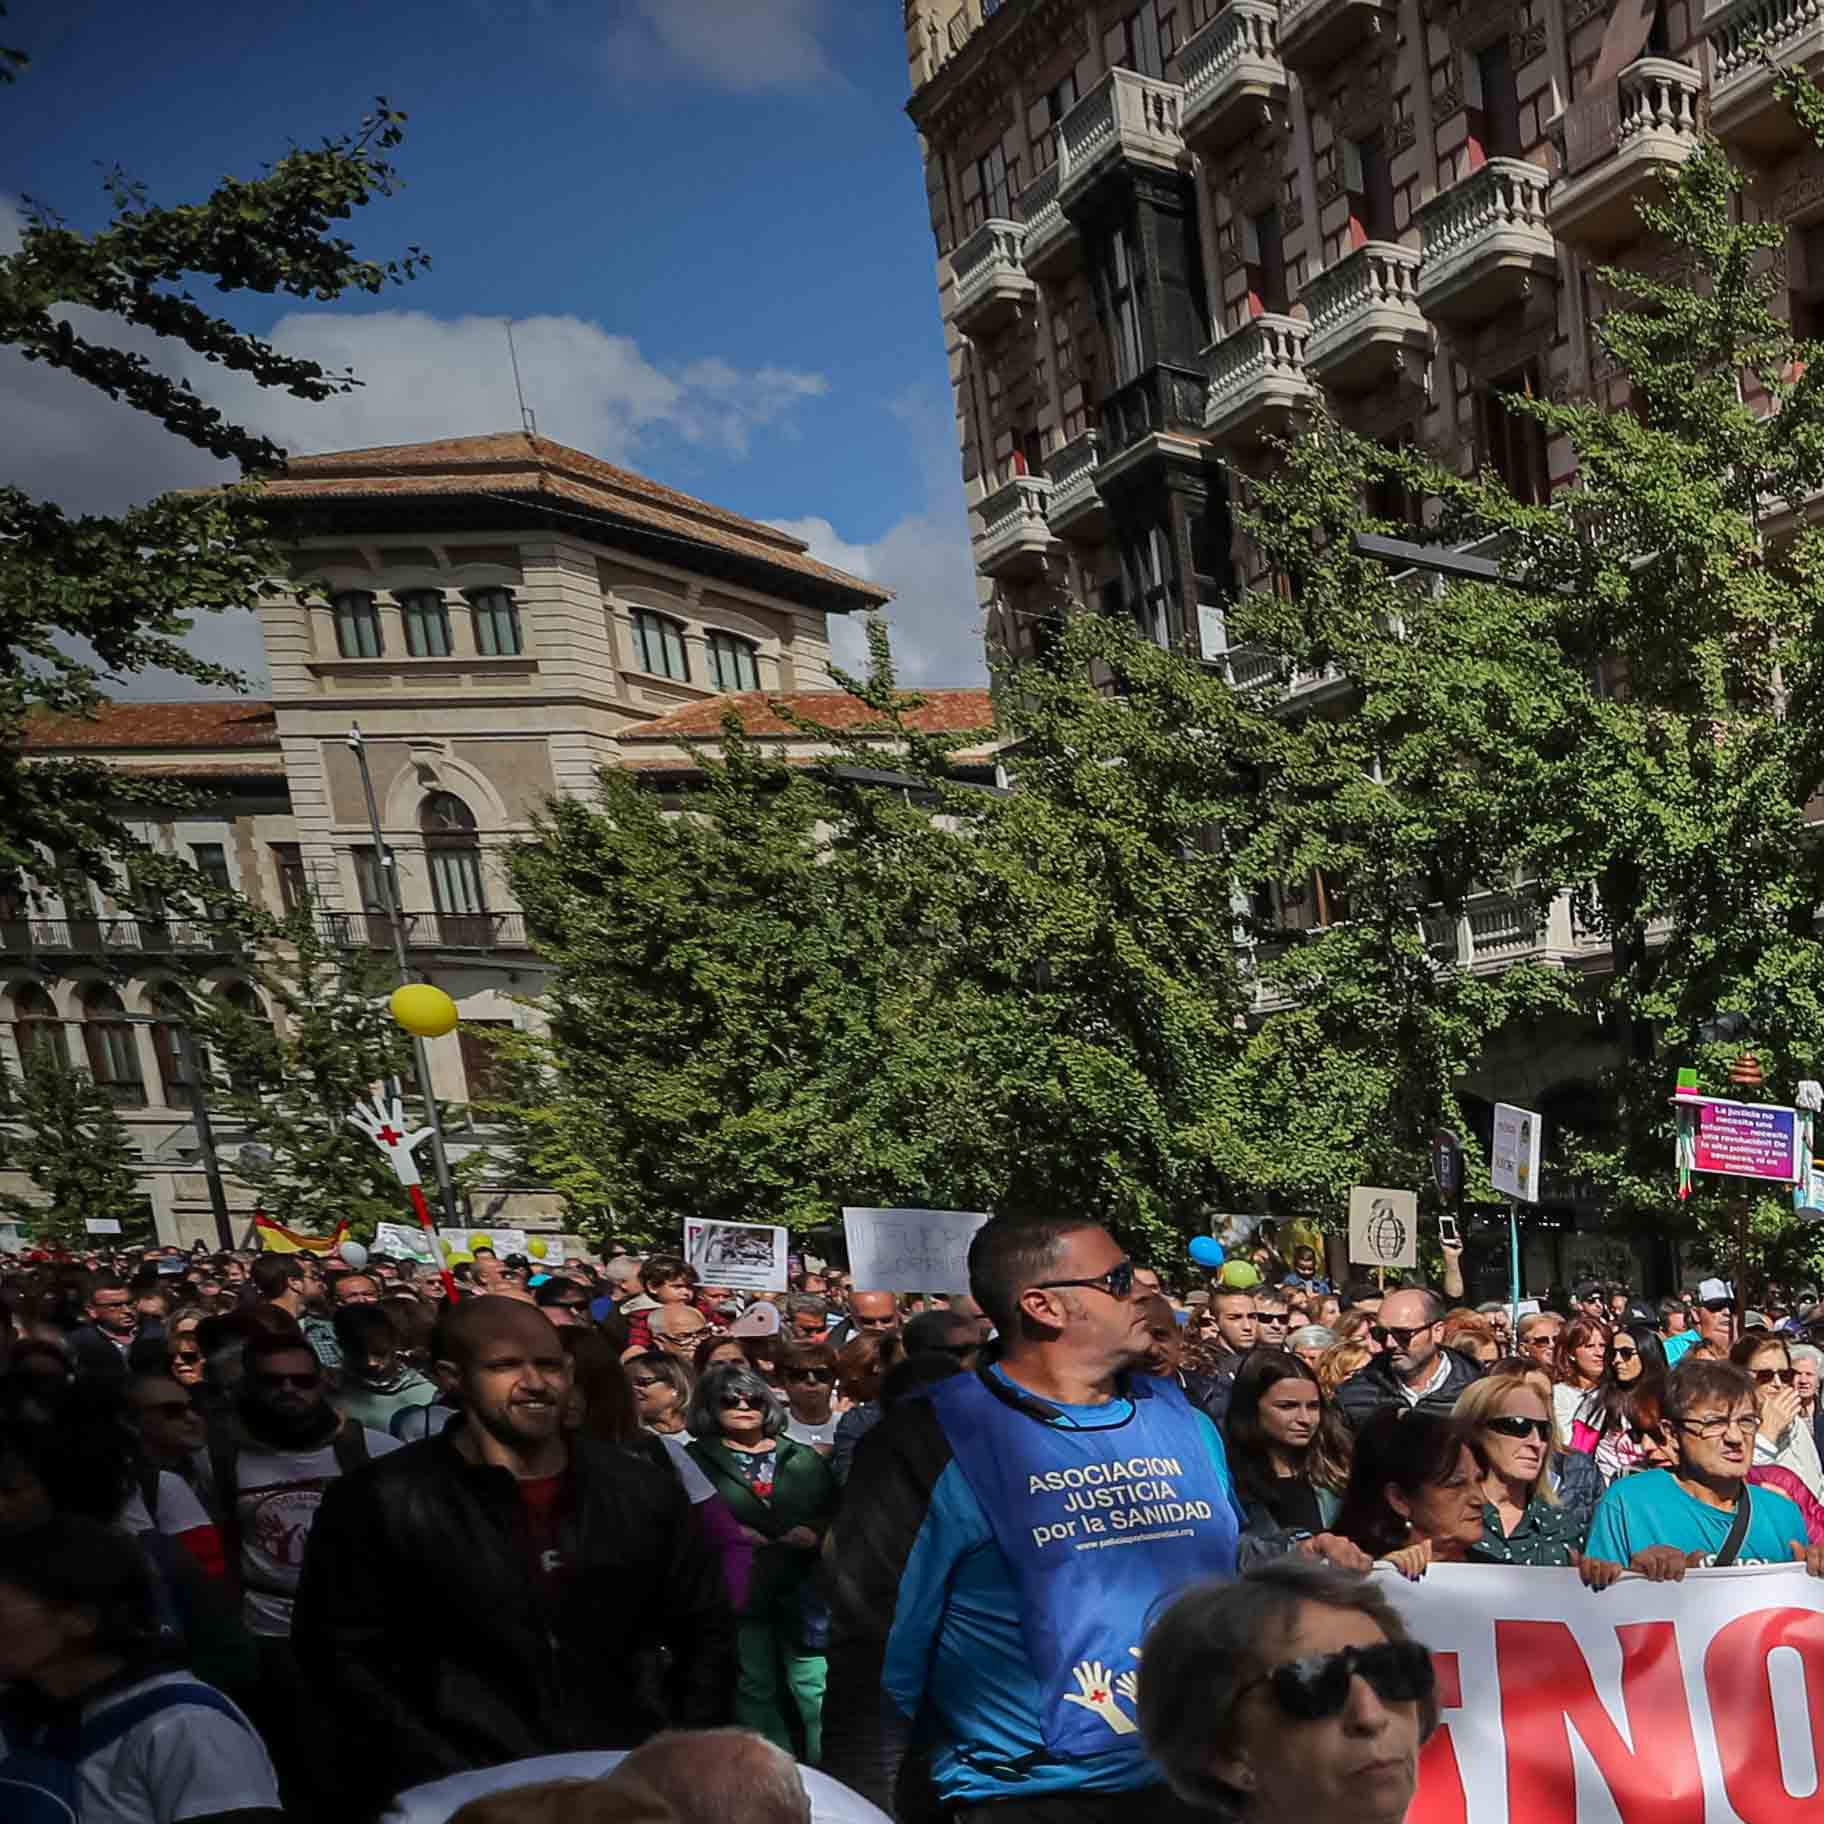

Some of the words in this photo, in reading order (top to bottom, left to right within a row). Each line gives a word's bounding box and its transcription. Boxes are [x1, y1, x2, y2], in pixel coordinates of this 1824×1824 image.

[1028, 1457, 1184, 1495] ASOCIACION
[1063, 1481, 1178, 1513] JUSTICIA
[1031, 1519, 1077, 1548] por
[1081, 1514, 1106, 1534] la
[1109, 1500, 1213, 1531] SANIDAD
